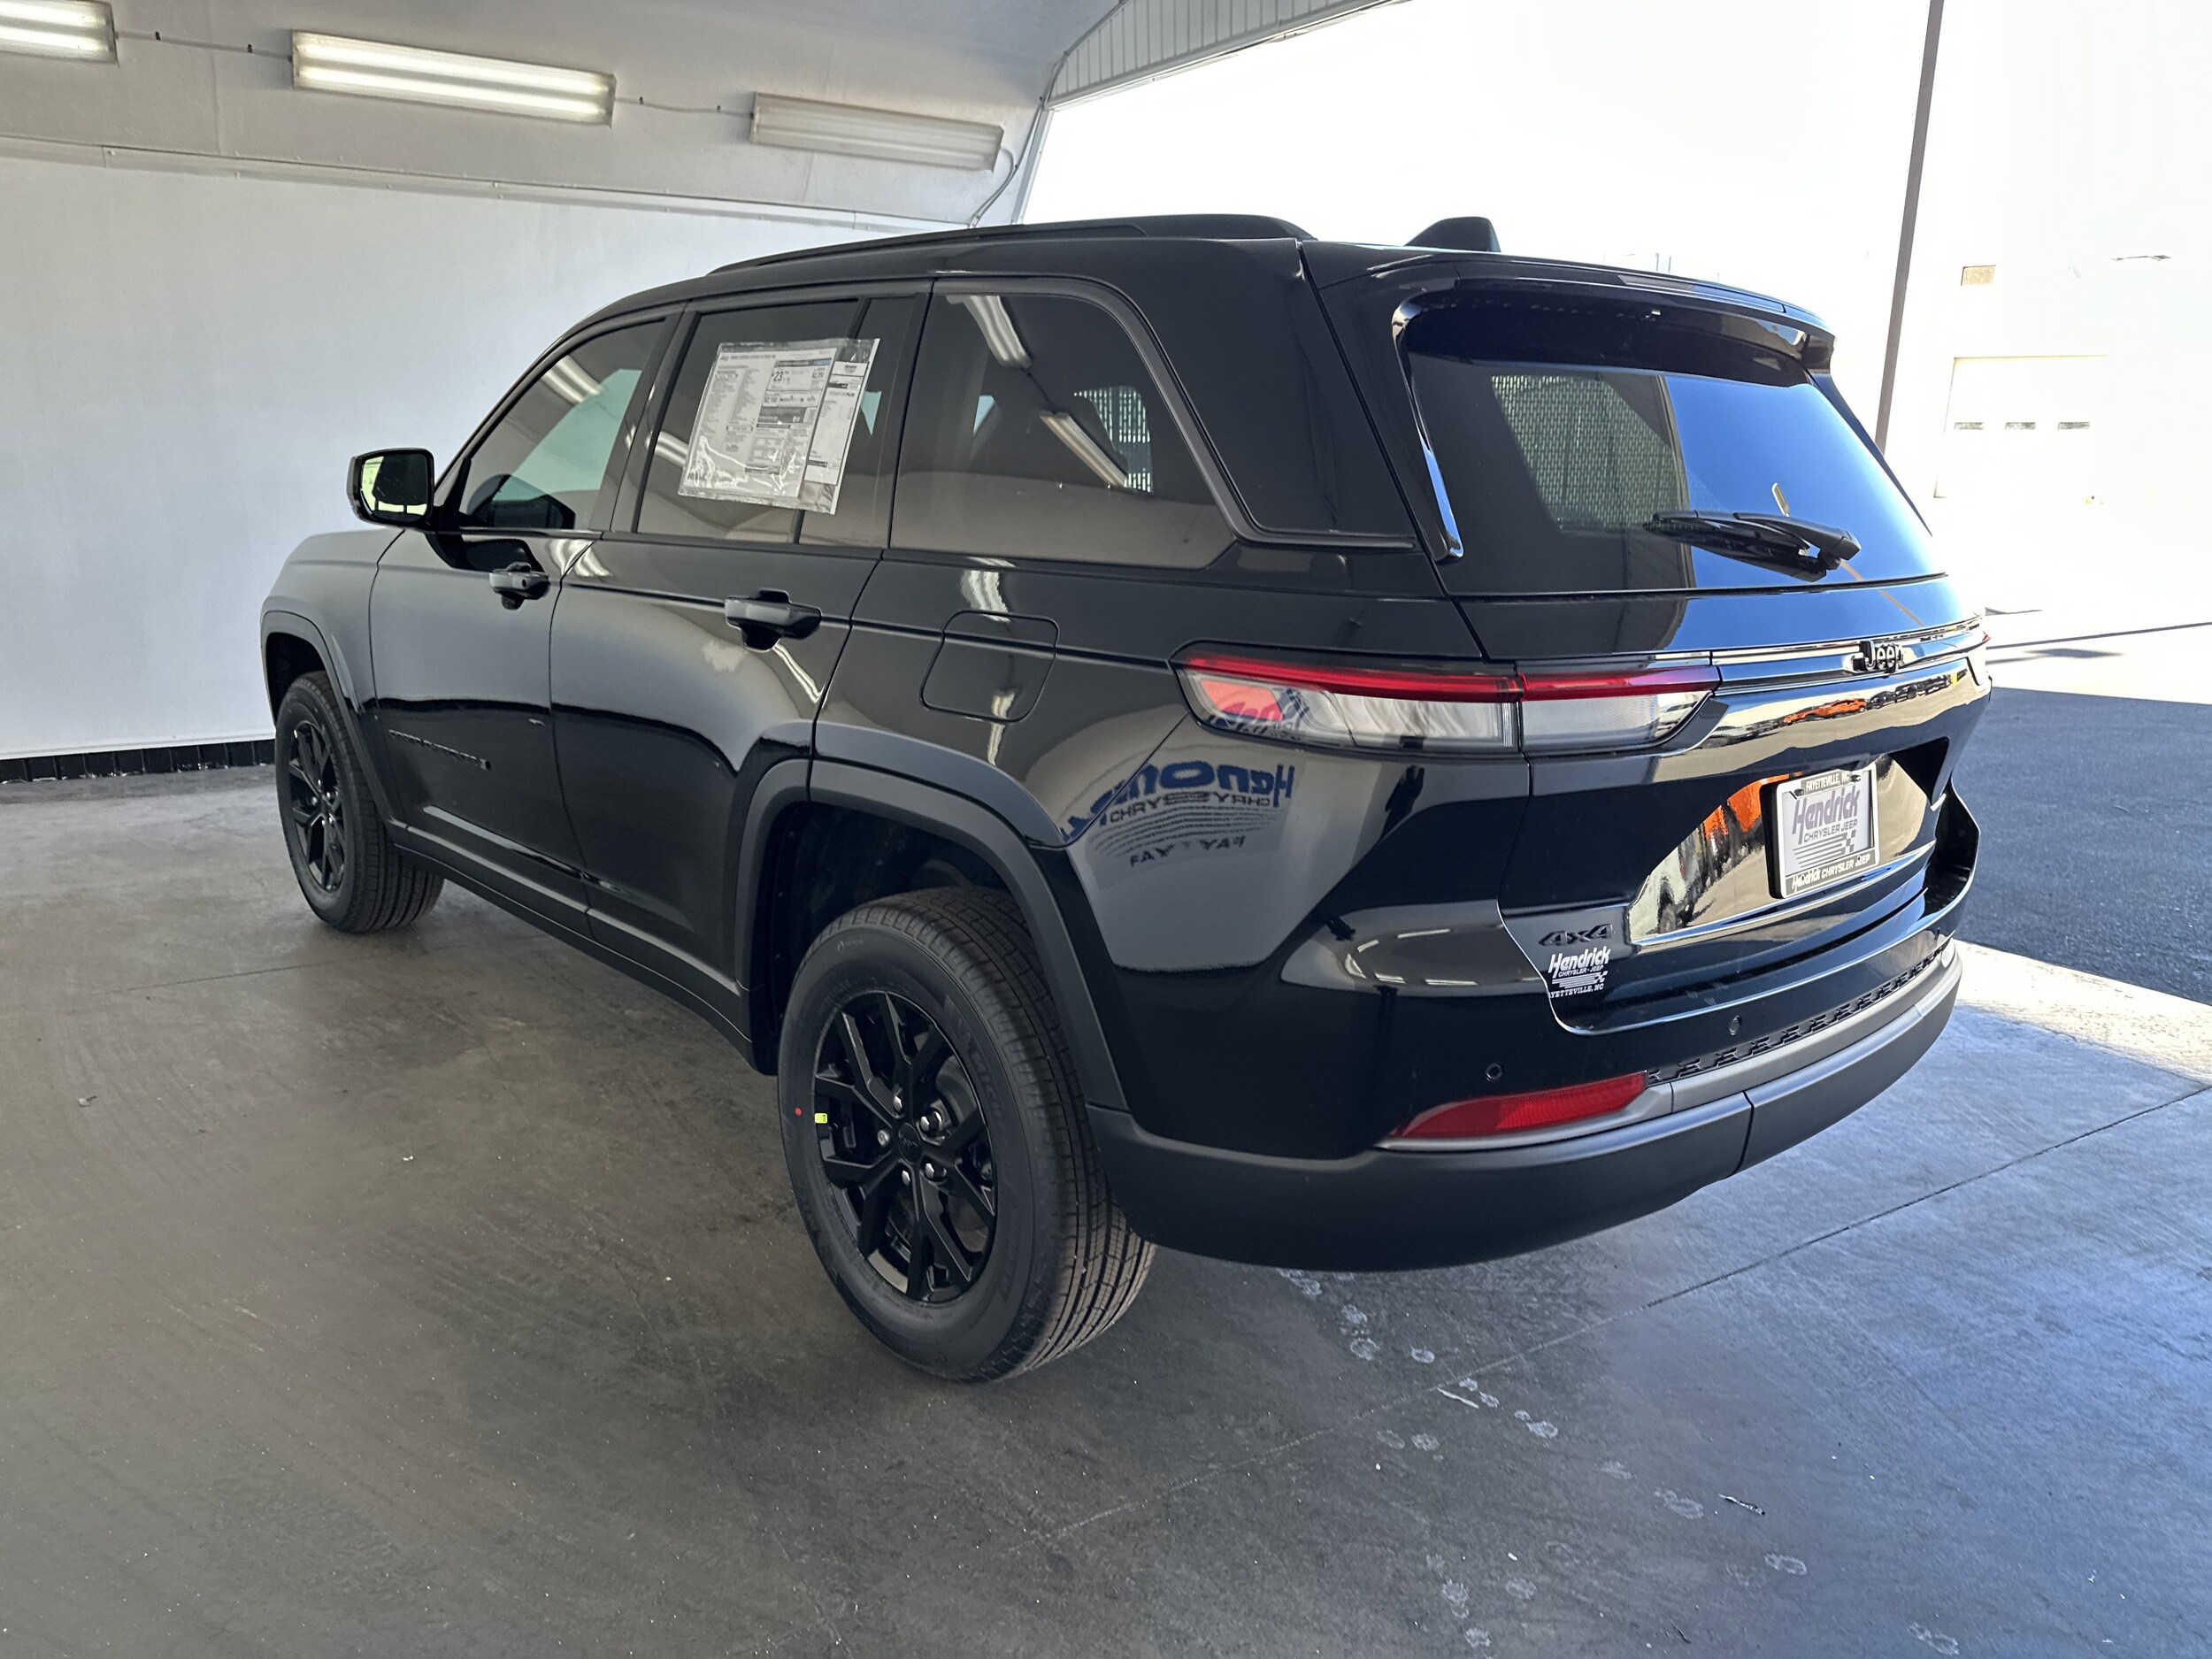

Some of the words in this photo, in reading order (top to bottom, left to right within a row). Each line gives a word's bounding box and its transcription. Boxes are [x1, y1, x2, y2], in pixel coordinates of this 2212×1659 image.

[1864, 640, 1904, 671] Jeep
[1792, 785, 1861, 845] Hendrick
[1803, 824, 1840, 843] CHRYSLER
[1840, 818, 1858, 833] JEEP
[1821, 859, 1855, 879] CHRYSLER
[1548, 946, 1611, 979] Hendrick
[1558, 967, 1587, 978] CHRYSLER
